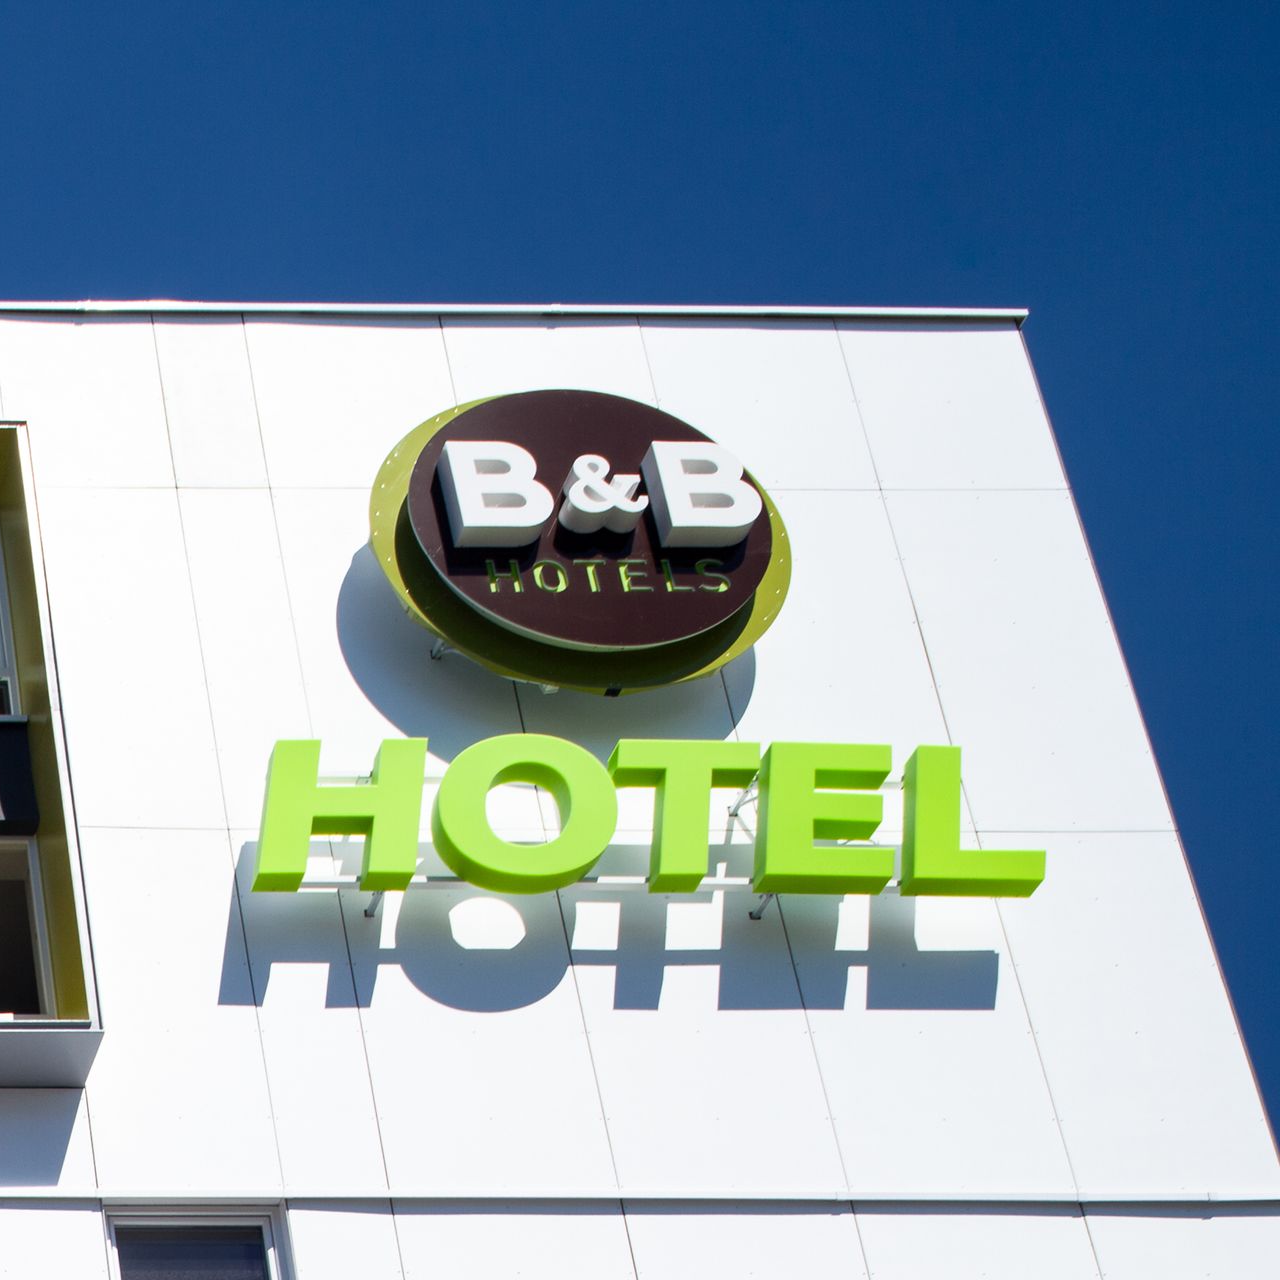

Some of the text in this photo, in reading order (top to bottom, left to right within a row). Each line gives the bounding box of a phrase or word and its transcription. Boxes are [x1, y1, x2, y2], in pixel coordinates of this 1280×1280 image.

[441, 440, 762, 547] B&B
[485, 559, 731, 593] HOTELS
[252, 734, 1046, 896] HOTEL
